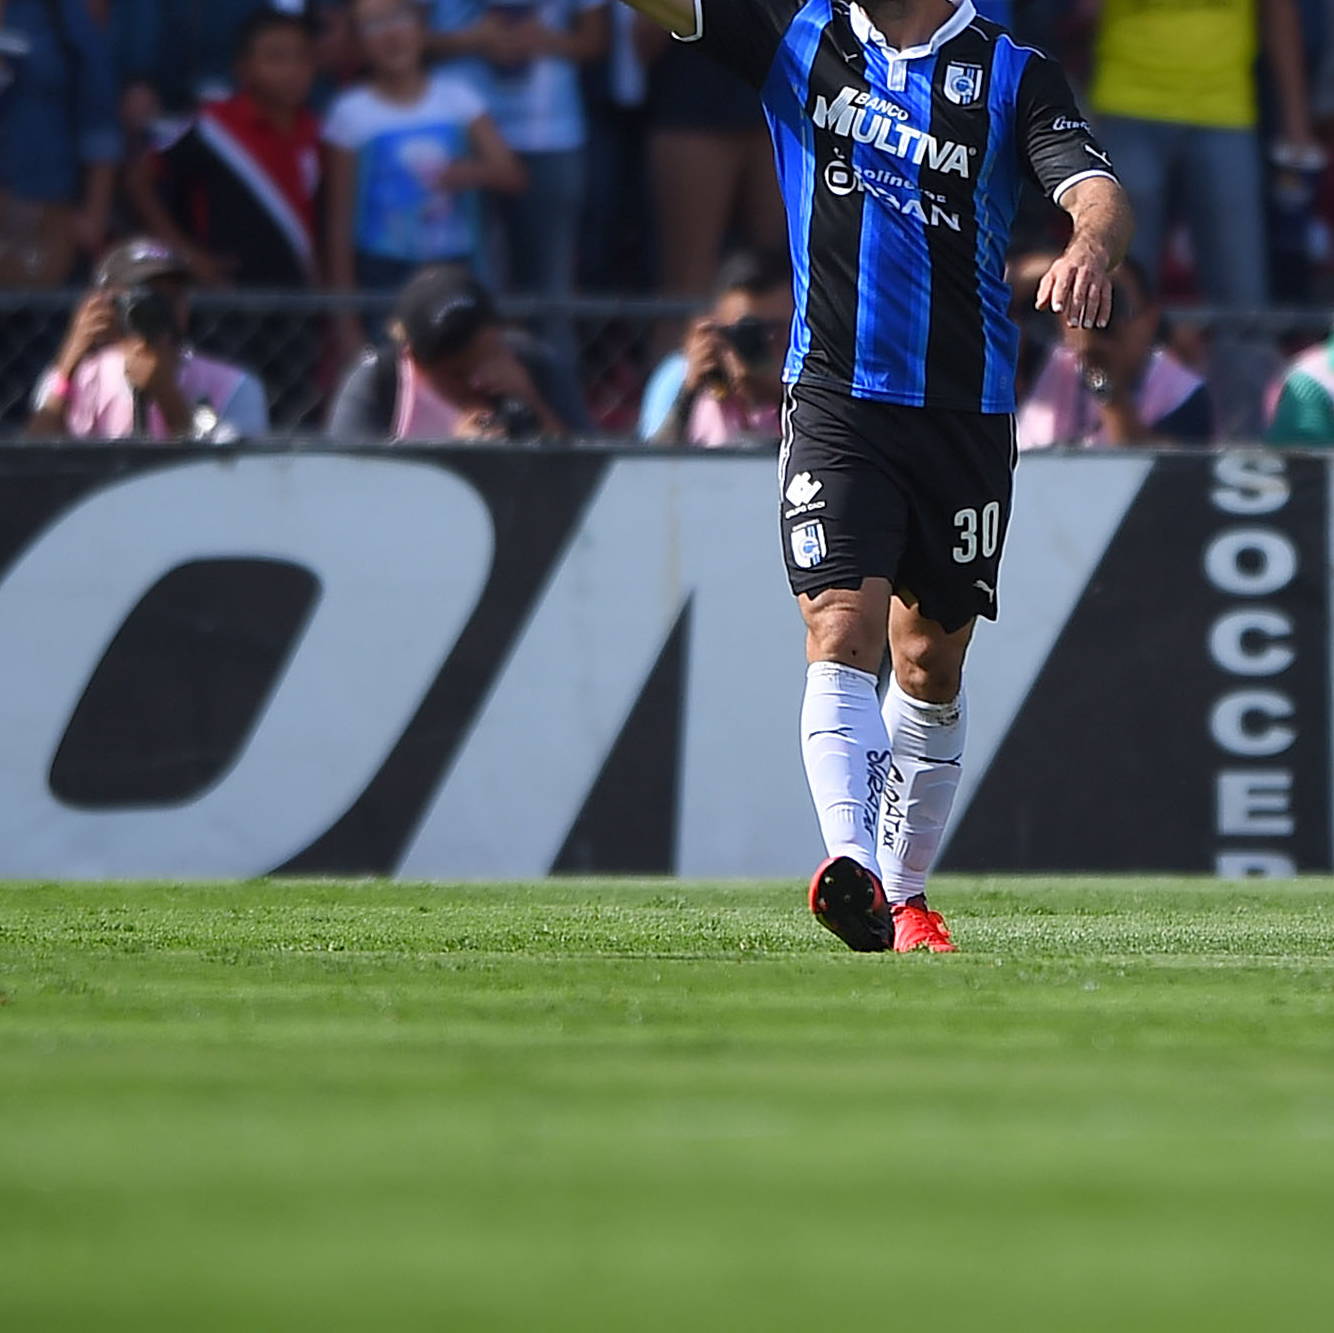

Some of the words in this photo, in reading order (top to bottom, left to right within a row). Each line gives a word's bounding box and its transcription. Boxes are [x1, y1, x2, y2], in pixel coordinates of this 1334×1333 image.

[812, 86, 970, 178] MULTIVA
[854, 93, 909, 121] BANCO
[953, 501, 1000, 564] 30
